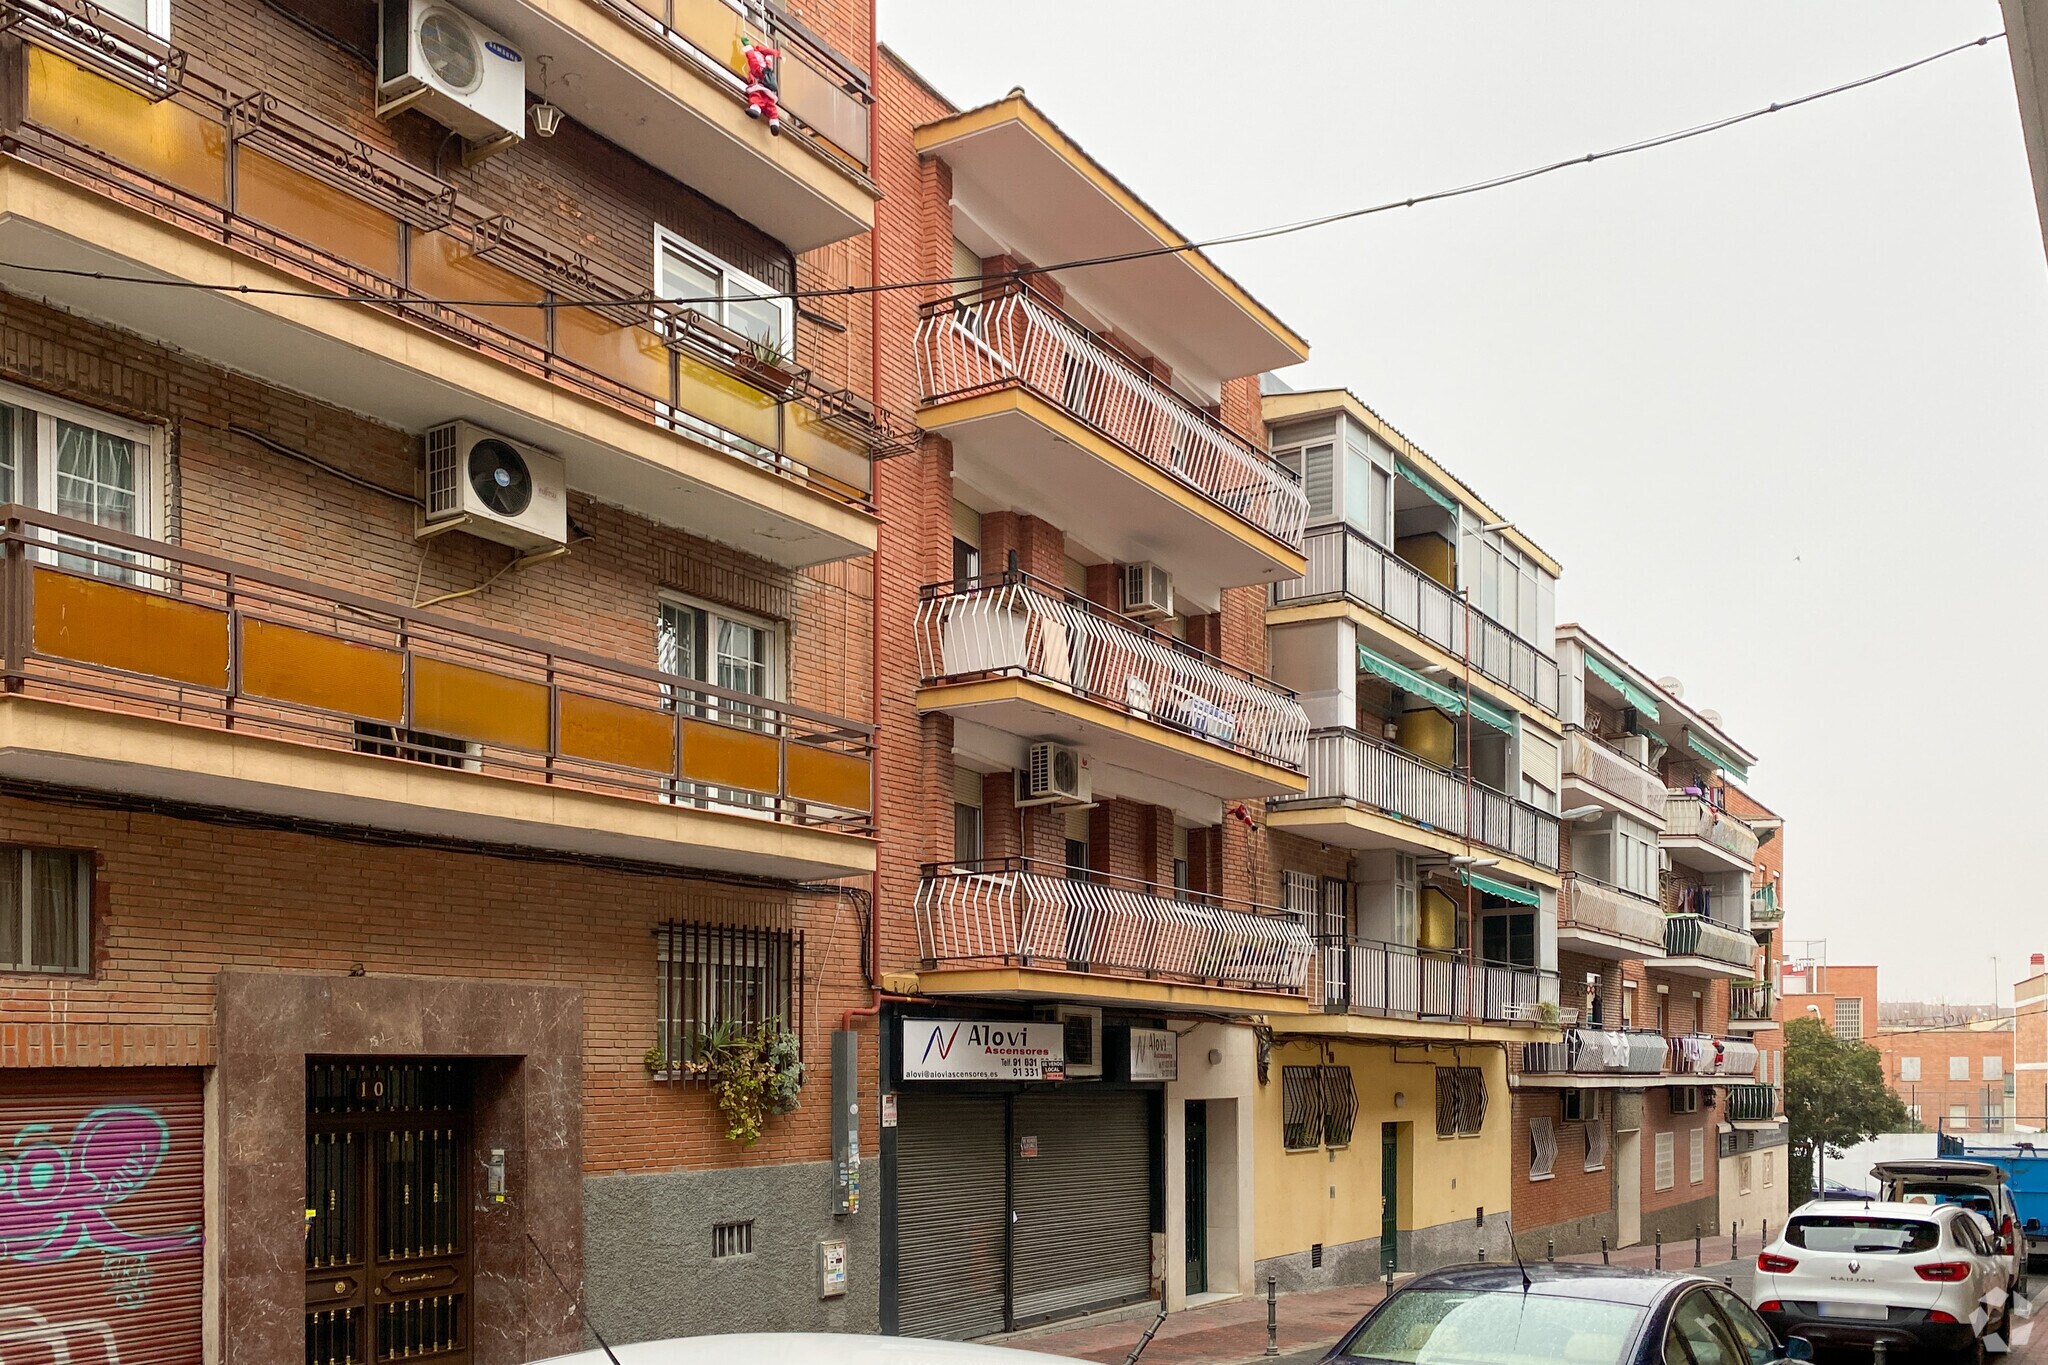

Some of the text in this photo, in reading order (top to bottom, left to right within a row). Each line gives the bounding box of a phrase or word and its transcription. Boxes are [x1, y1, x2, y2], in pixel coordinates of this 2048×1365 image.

[489, 41, 518, 62] SAMSUNG
[968, 1024, 1028, 1046] Alovi
[1149, 1033, 1167, 1051] Alovi
[984, 1046, 1049, 1056] Ascensores
[1012, 1058, 1021, 1067] 91
[1024, 1058, 1037, 1067] 831
[905, 1070, 998, 1078] alovi@aloviascensores.es
[1012, 1068, 1021, 1077] 91
[1024, 1068, 1039, 1077] 331
[361, 1081, 384, 1097] 10
